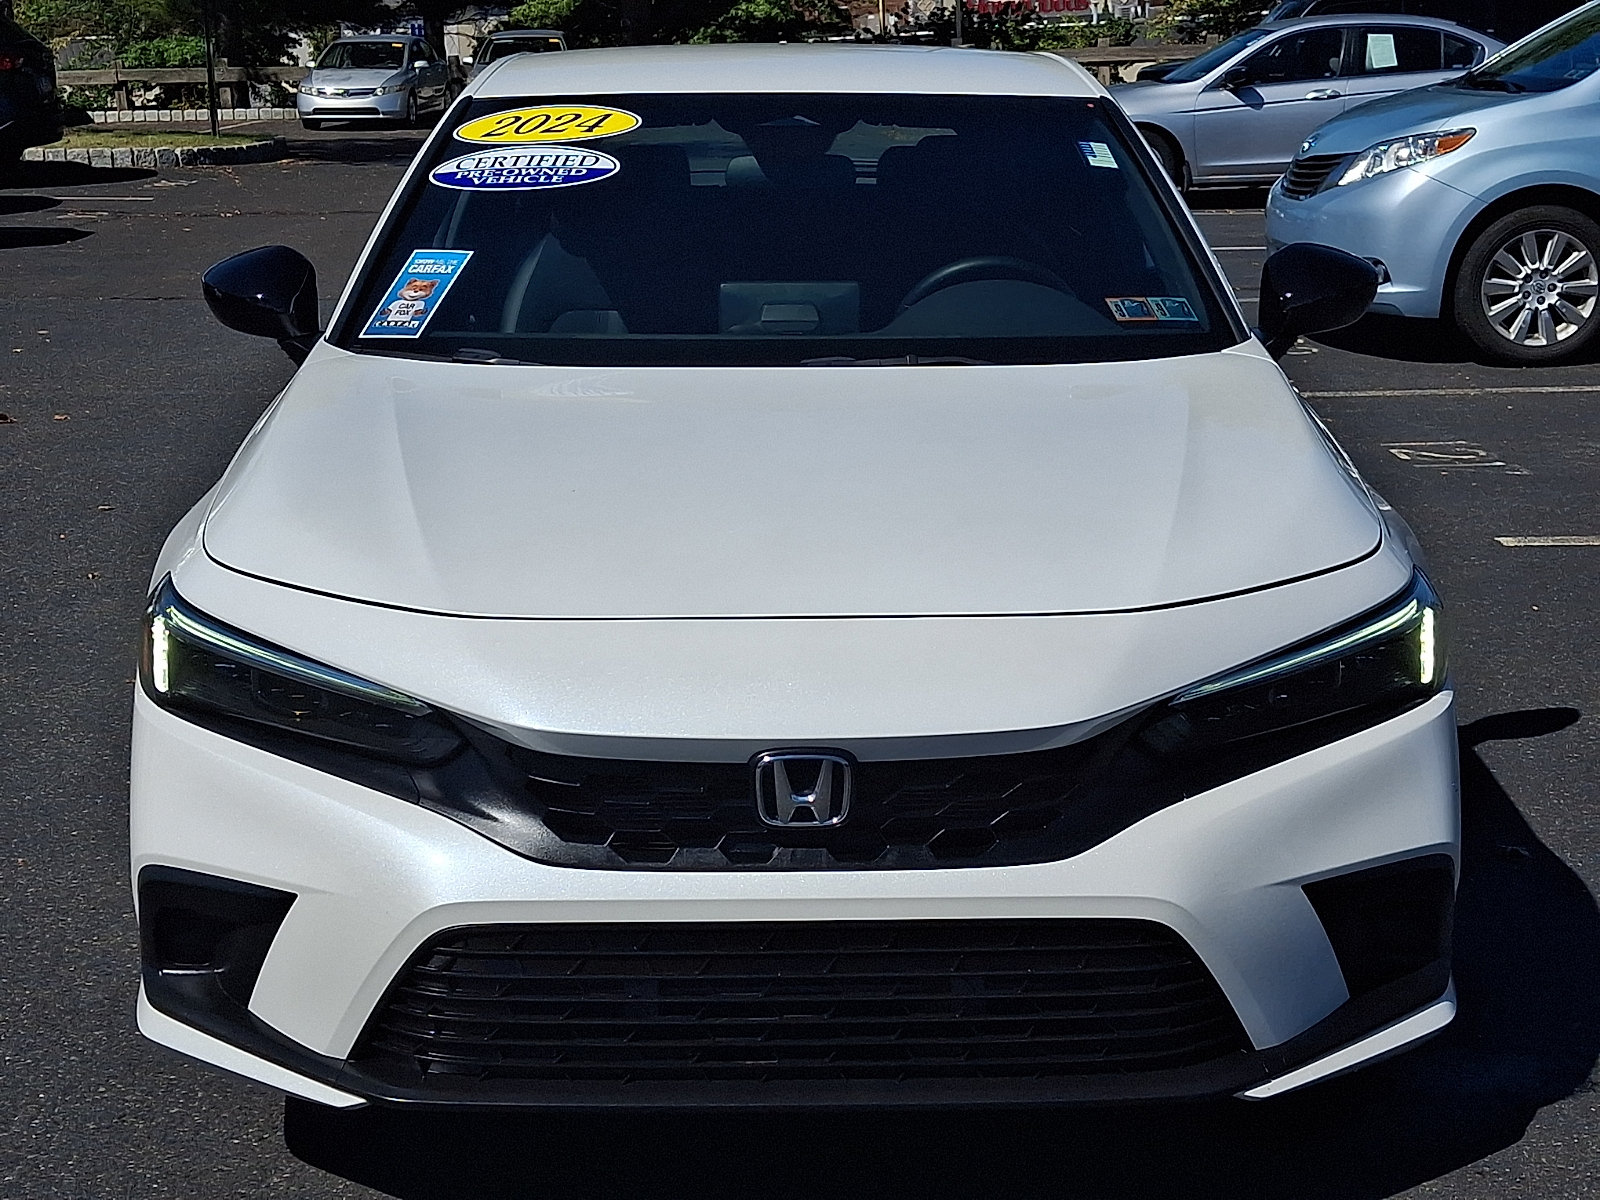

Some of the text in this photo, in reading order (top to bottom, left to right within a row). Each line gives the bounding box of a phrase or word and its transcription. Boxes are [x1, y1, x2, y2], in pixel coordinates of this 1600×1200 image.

[481, 113, 614, 138] 2024
[456, 154, 600, 171] CERTIFIED
[456, 167, 588, 181] PRE-OWNED
[472, 173, 565, 184] VEHICLE
[408, 264, 456, 274] CARFAX
